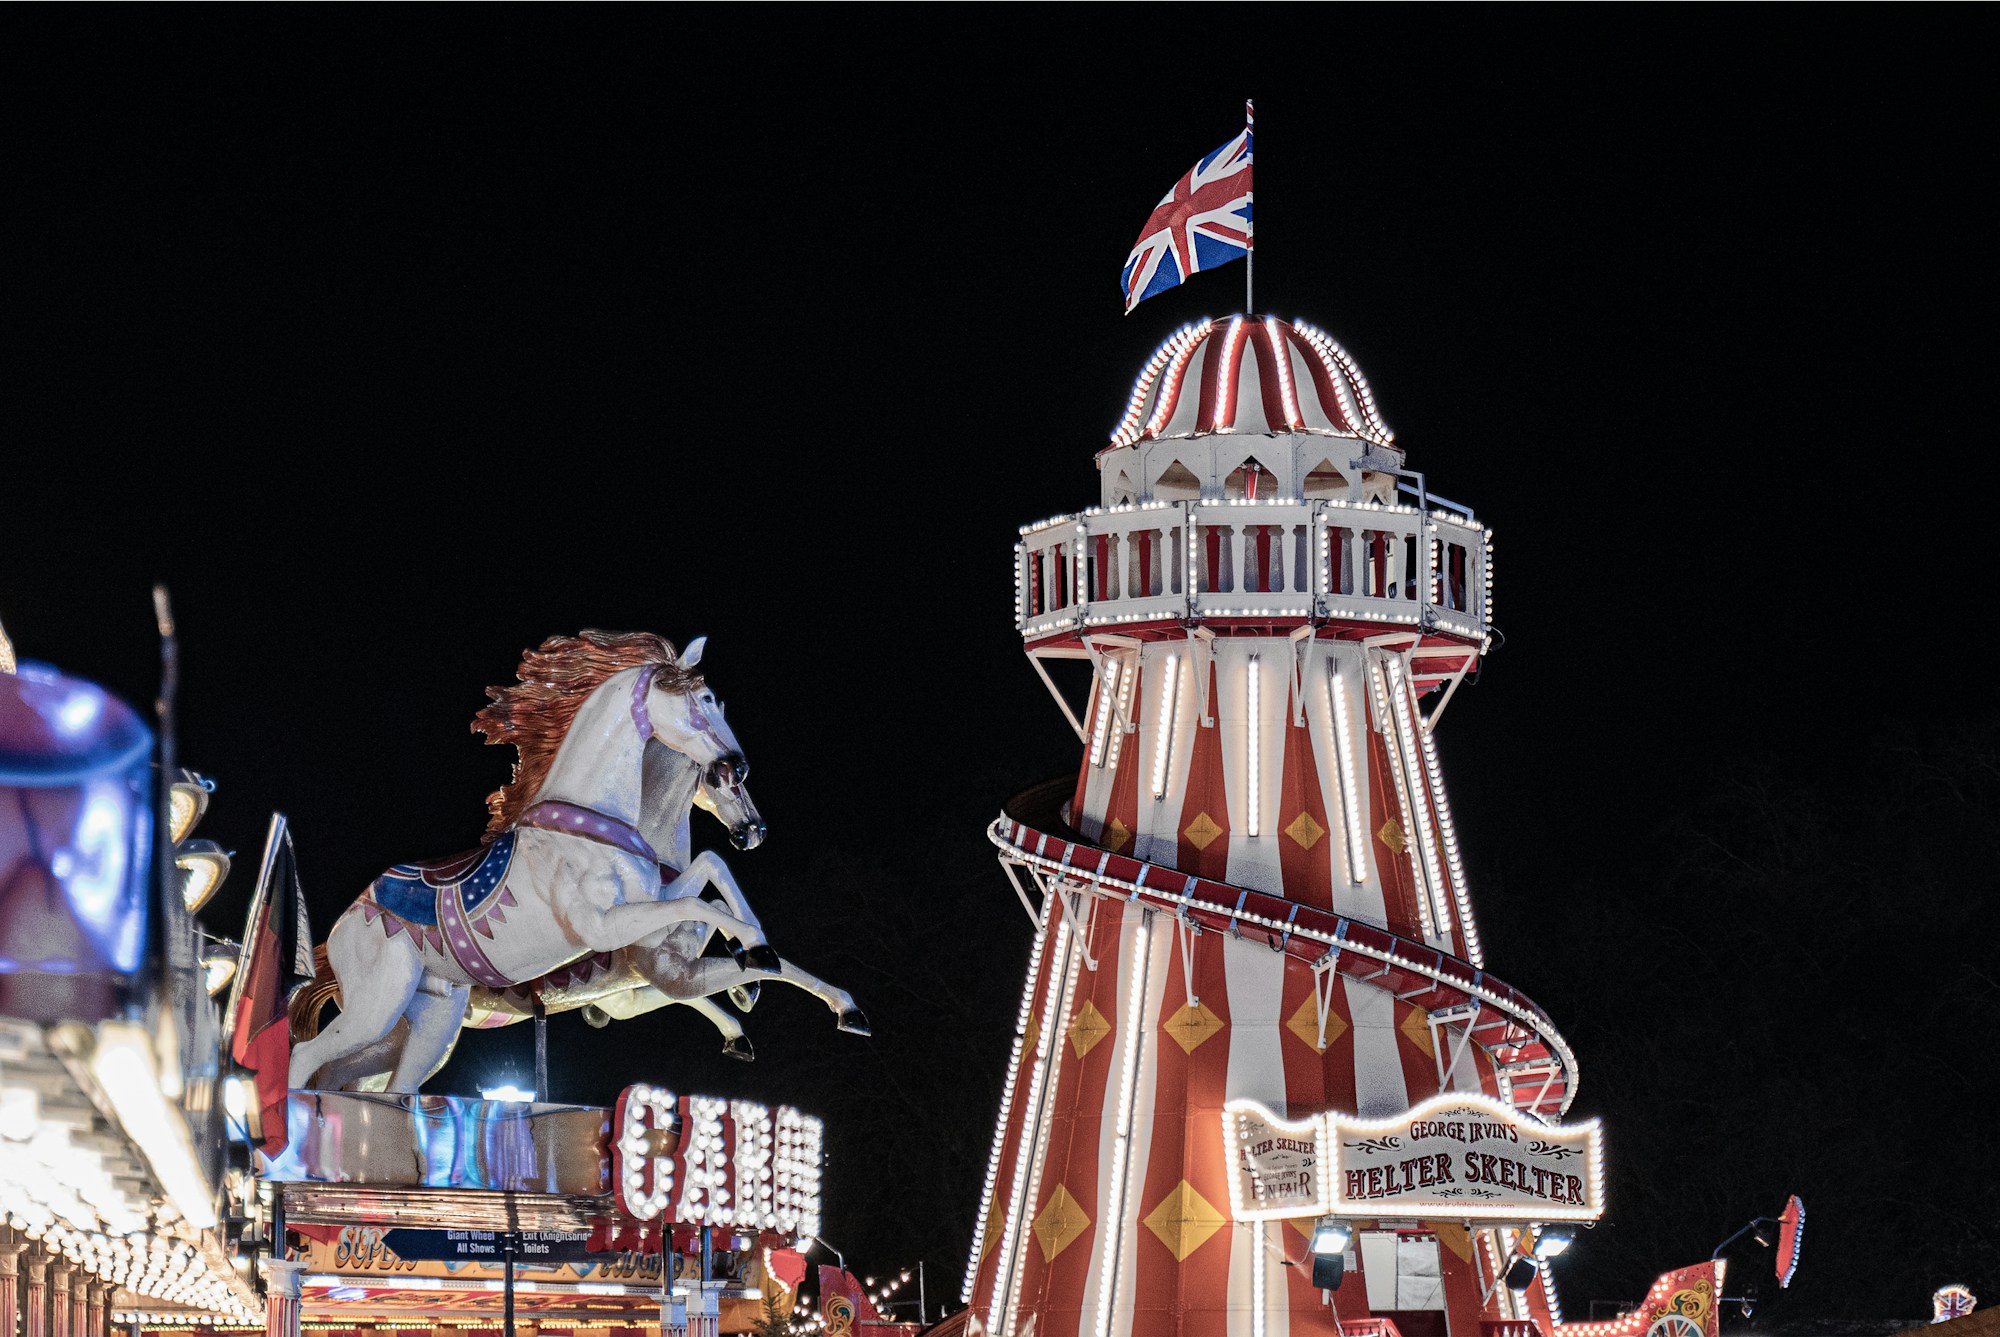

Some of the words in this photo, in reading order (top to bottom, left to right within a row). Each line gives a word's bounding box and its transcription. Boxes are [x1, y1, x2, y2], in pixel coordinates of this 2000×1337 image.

[1410, 1120, 1466, 1143] GEORGE
[1469, 1122, 1518, 1144] IRVIN'S
[1240, 1139, 1274, 1161] HLTER
[1276, 1137, 1316, 1155] SKELTER
[1279, 1171, 1311, 1198] FAIR
[1345, 1152, 1453, 1200] HELTER
[1464, 1151, 1585, 1206] SKELTER
[447, 1231, 469, 1240] Giant
[471, 1231, 495, 1241] Wheel
[522, 1232, 538, 1241] Exit
[457, 1243, 468, 1254] All
[469, 1243, 495, 1254] Shows
[523, 1243, 549, 1254] Toilets
